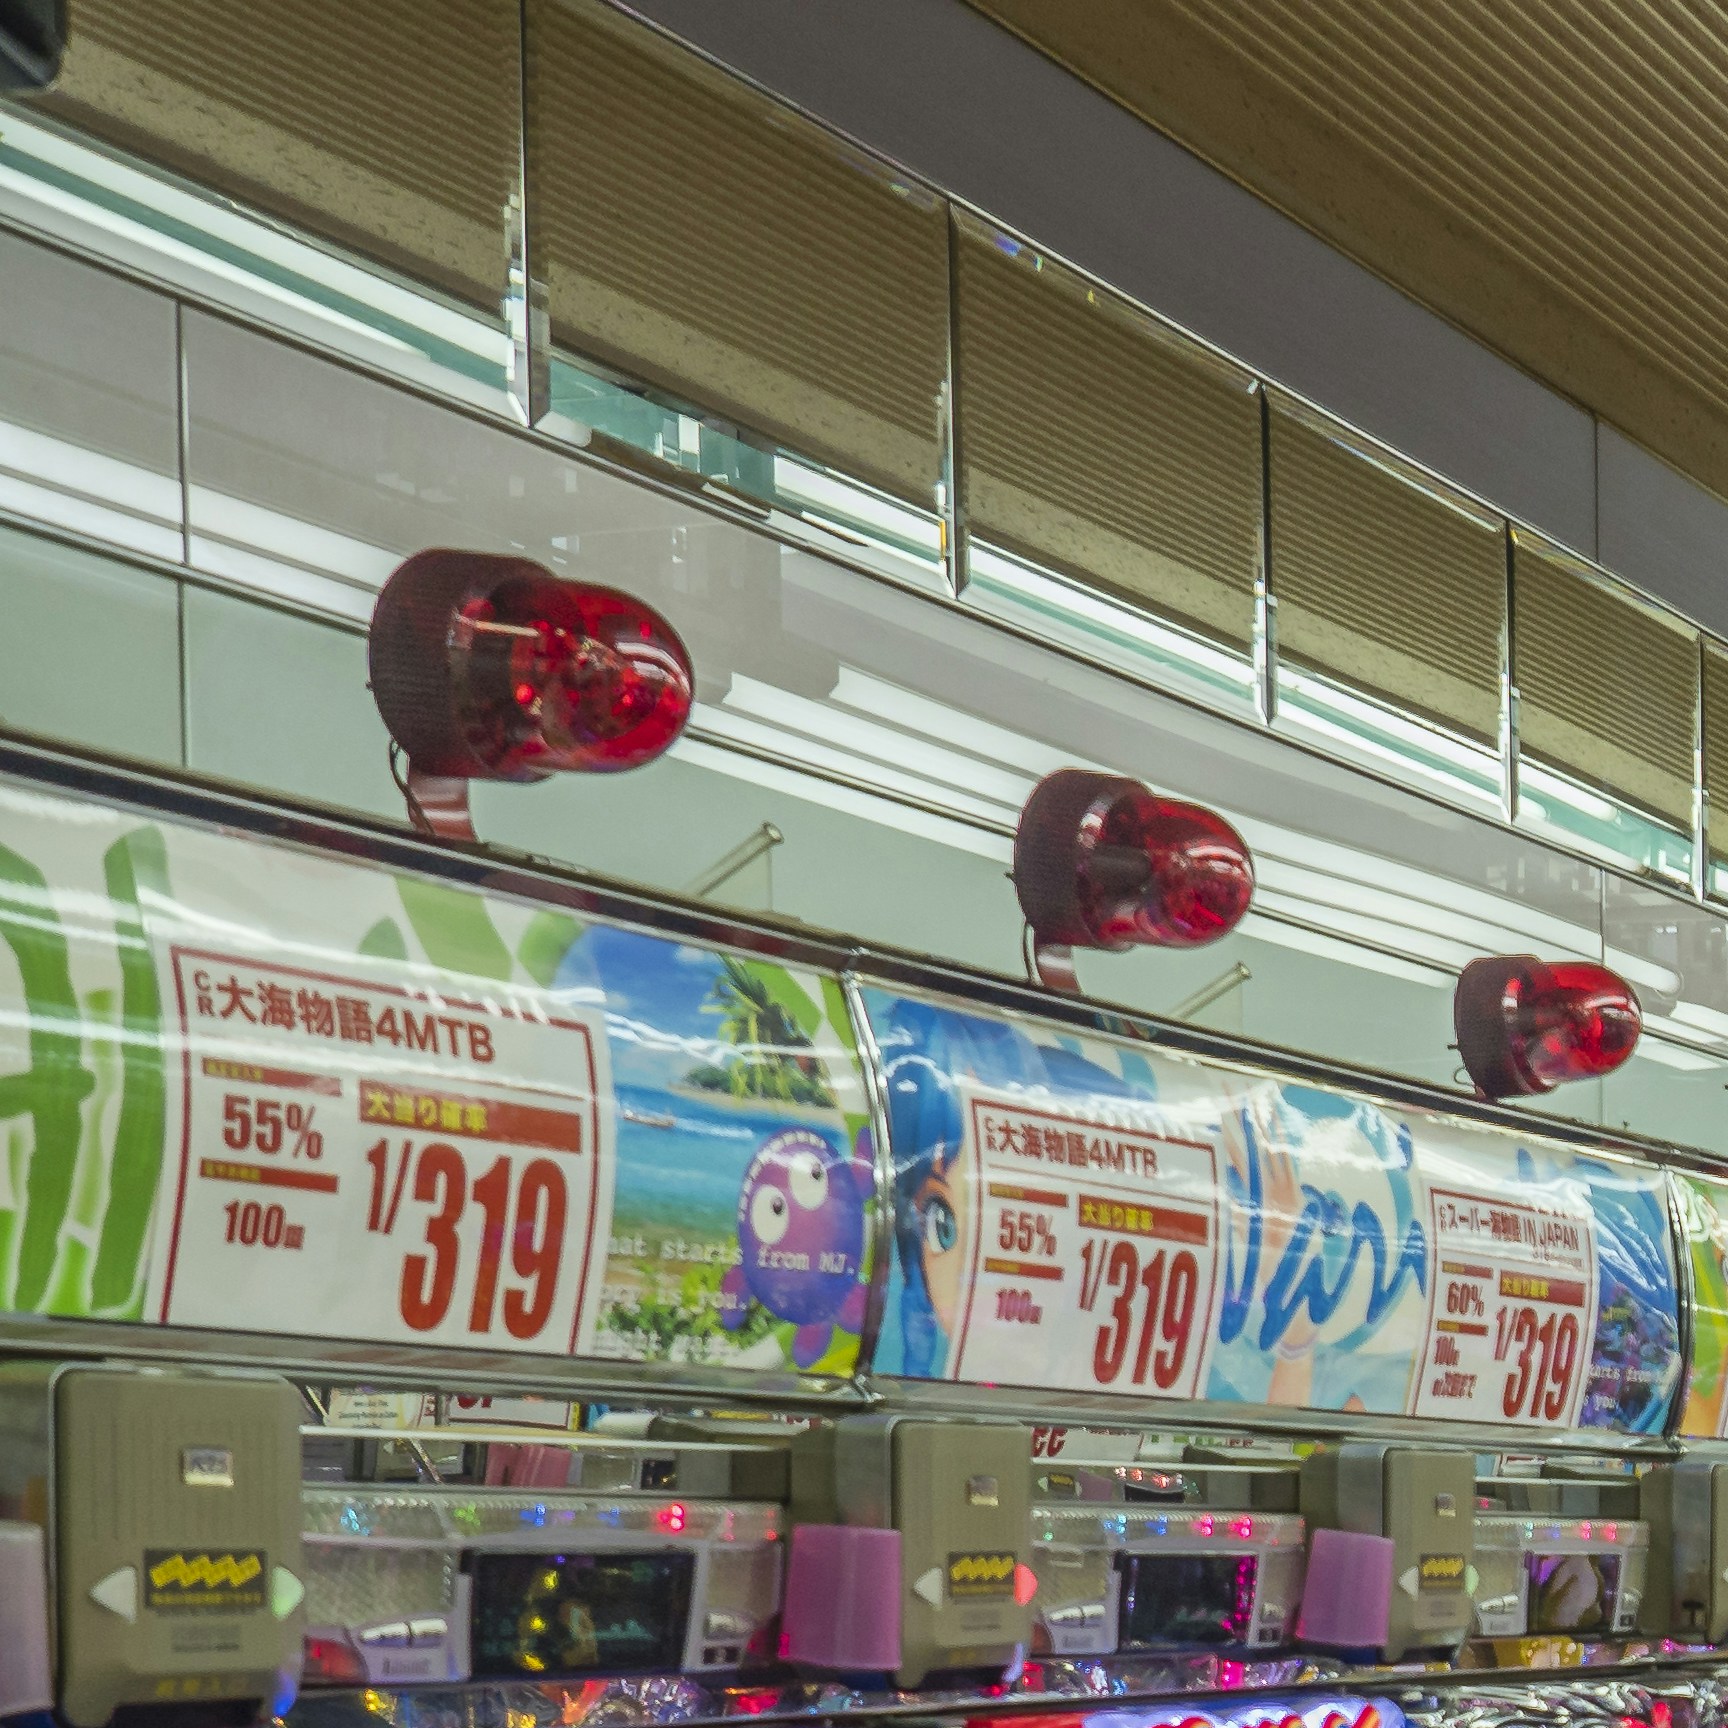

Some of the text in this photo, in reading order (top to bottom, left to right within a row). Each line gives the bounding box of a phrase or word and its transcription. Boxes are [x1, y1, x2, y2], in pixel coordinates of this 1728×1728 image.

[223, 1094, 324, 1161] 55%
[366, 1138, 569, 1340] 1/319
[758, 1243, 810, 1270] from
[1000, 1209, 1057, 1257] 55%
[1079, 1239, 1197, 1389] 1/319
[1447, 1282, 1484, 1316] 60%
